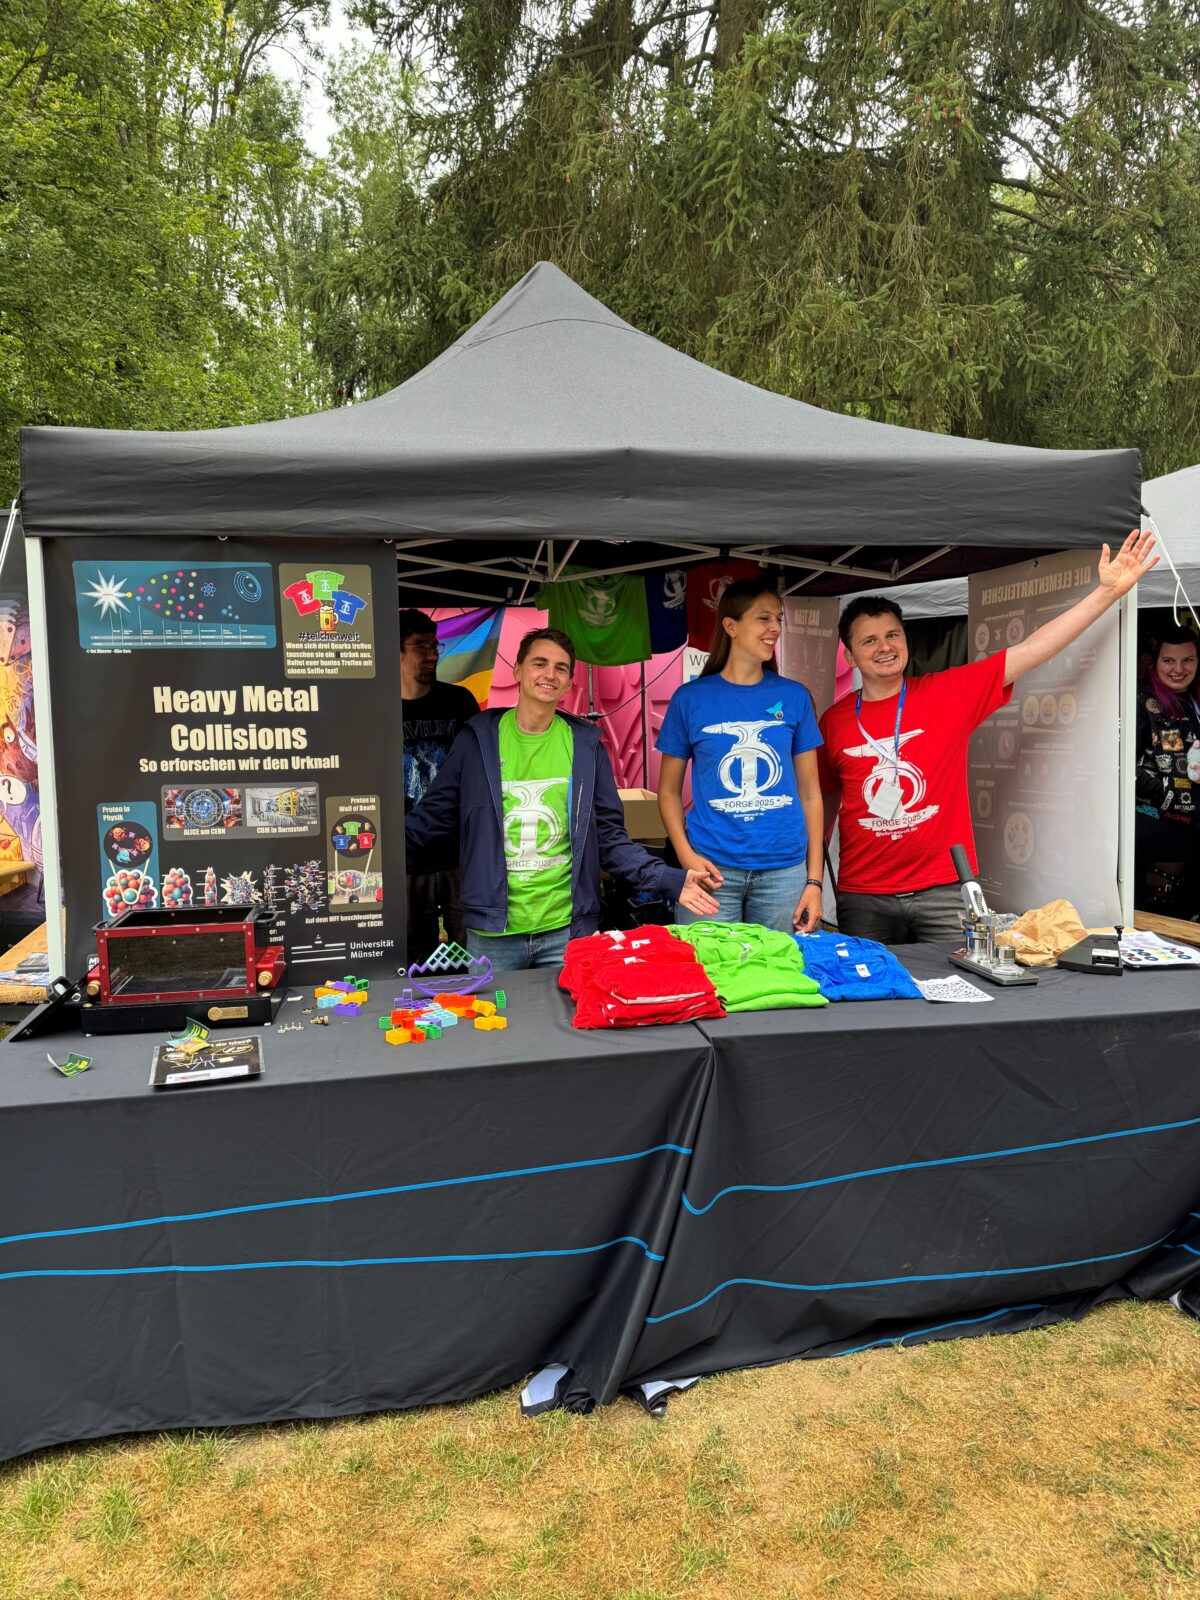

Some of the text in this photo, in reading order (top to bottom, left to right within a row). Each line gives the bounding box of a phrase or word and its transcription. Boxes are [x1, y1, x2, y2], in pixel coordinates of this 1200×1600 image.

[298, 631, 361, 642] #teilchenwelt
[153, 686, 319, 715] Heavy Metal
[171, 724, 308, 751] Collisions
[139, 755, 340, 772] So erforschen wir den Urknall
[724, 799, 774, 808] FORGE 2025
[872, 813, 922, 827] FORGE 2025
[340, 913, 382, 922] beschleunigen
[350, 940, 394, 950] Universität
[350, 950, 384, 959] Münster
